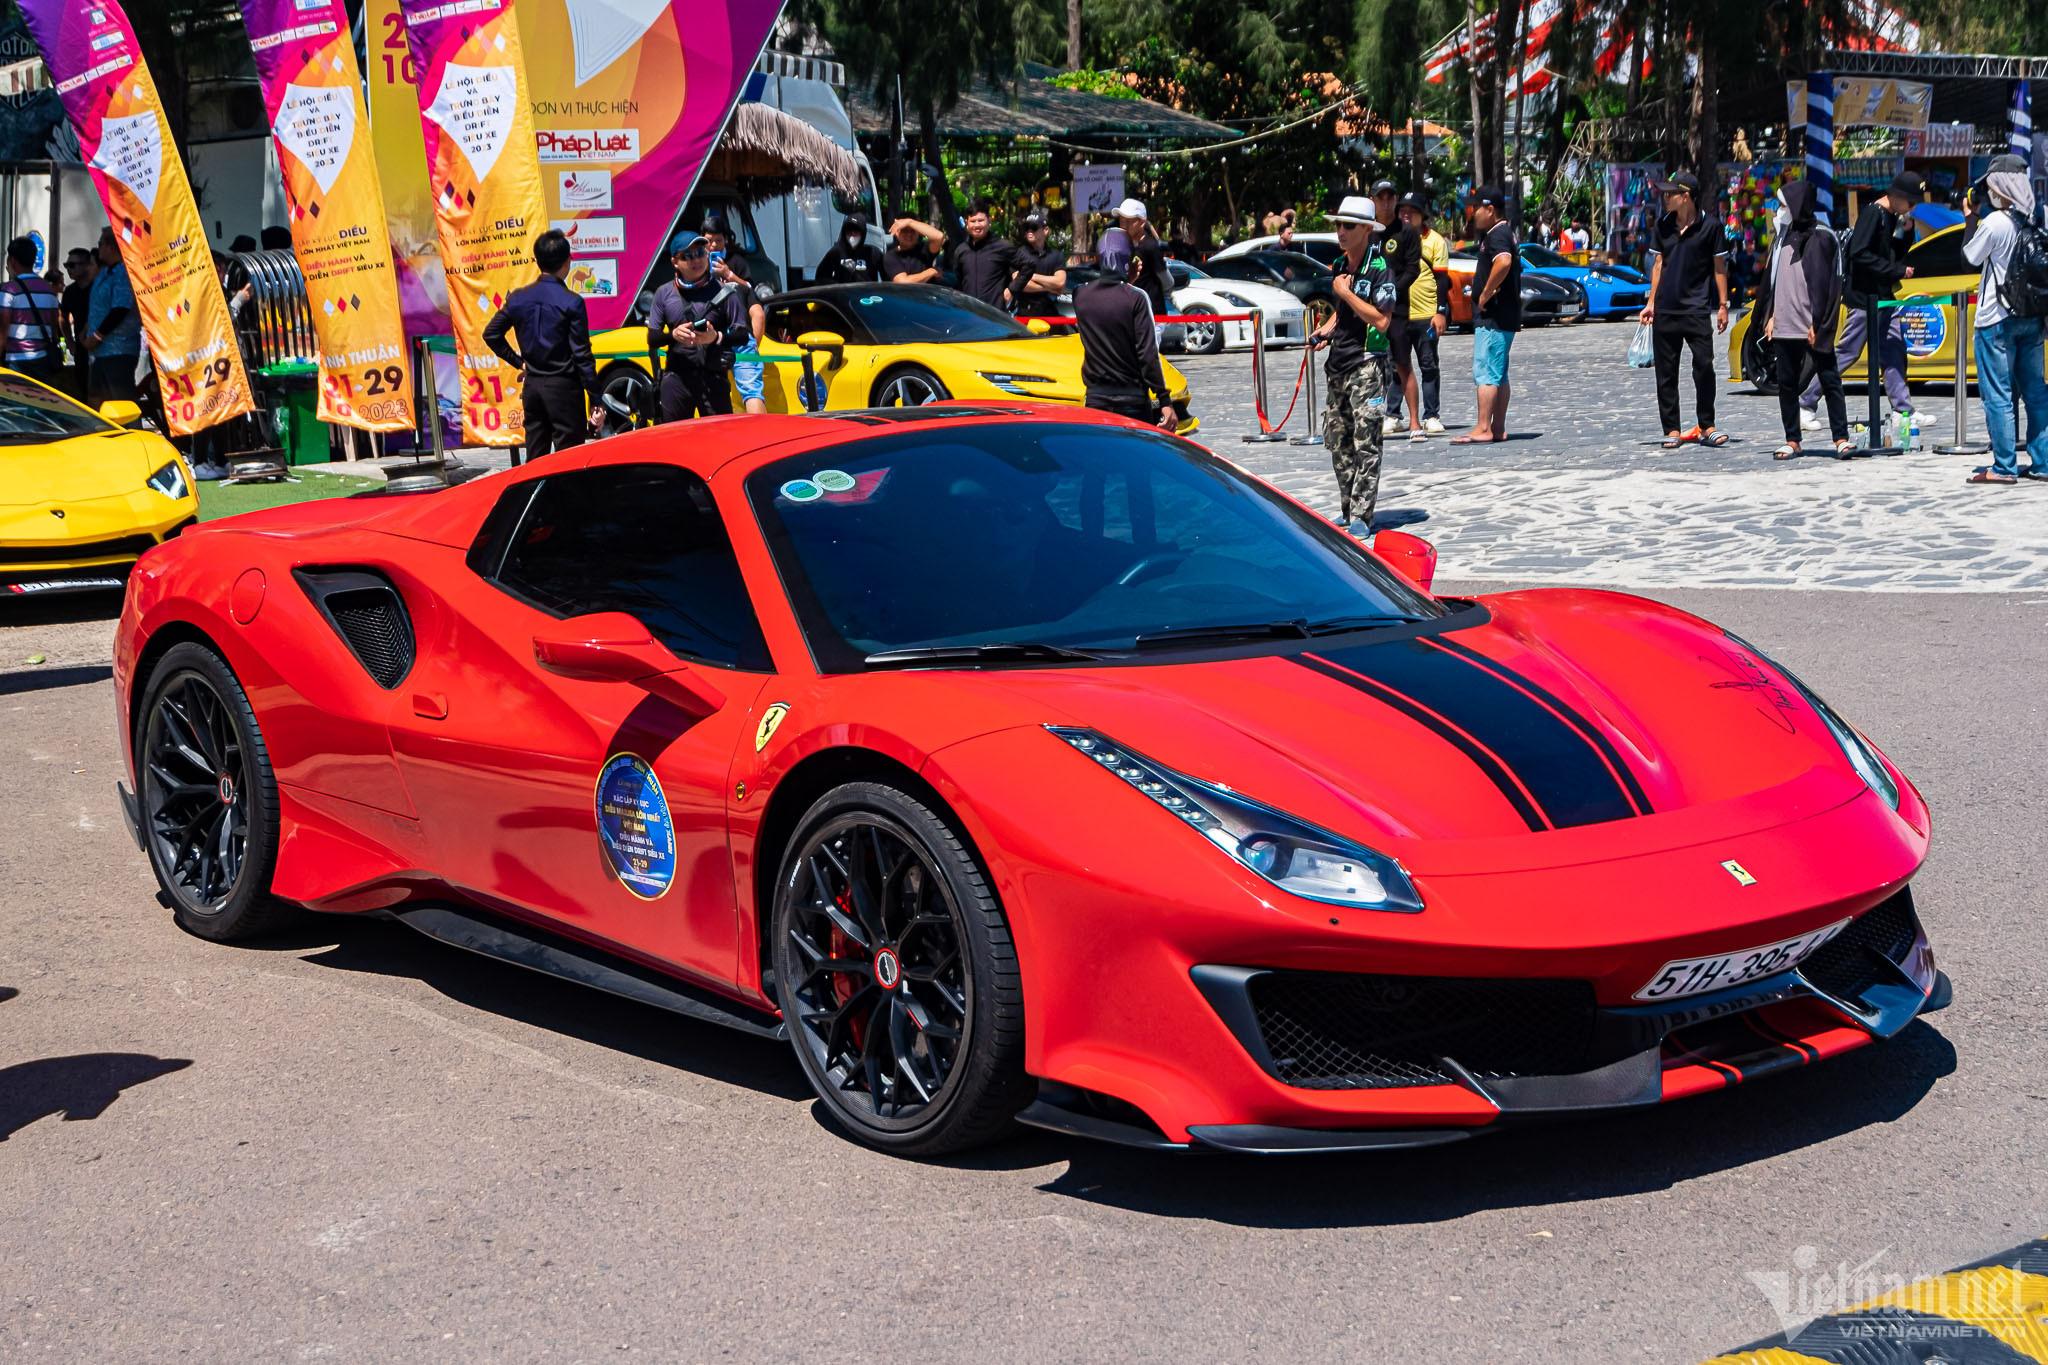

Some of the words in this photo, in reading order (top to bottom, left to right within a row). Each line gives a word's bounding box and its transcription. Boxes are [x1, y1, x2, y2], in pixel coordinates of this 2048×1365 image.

[560, 101, 573, 117] VỊ
[576, 100, 608, 116] THỰC
[611, 98, 639, 116] HIỆN
[203, 357, 232, 389] 29
[364, 365, 404, 396] 29
[467, 375, 504, 404] 21
[467, 406, 501, 431] 10
